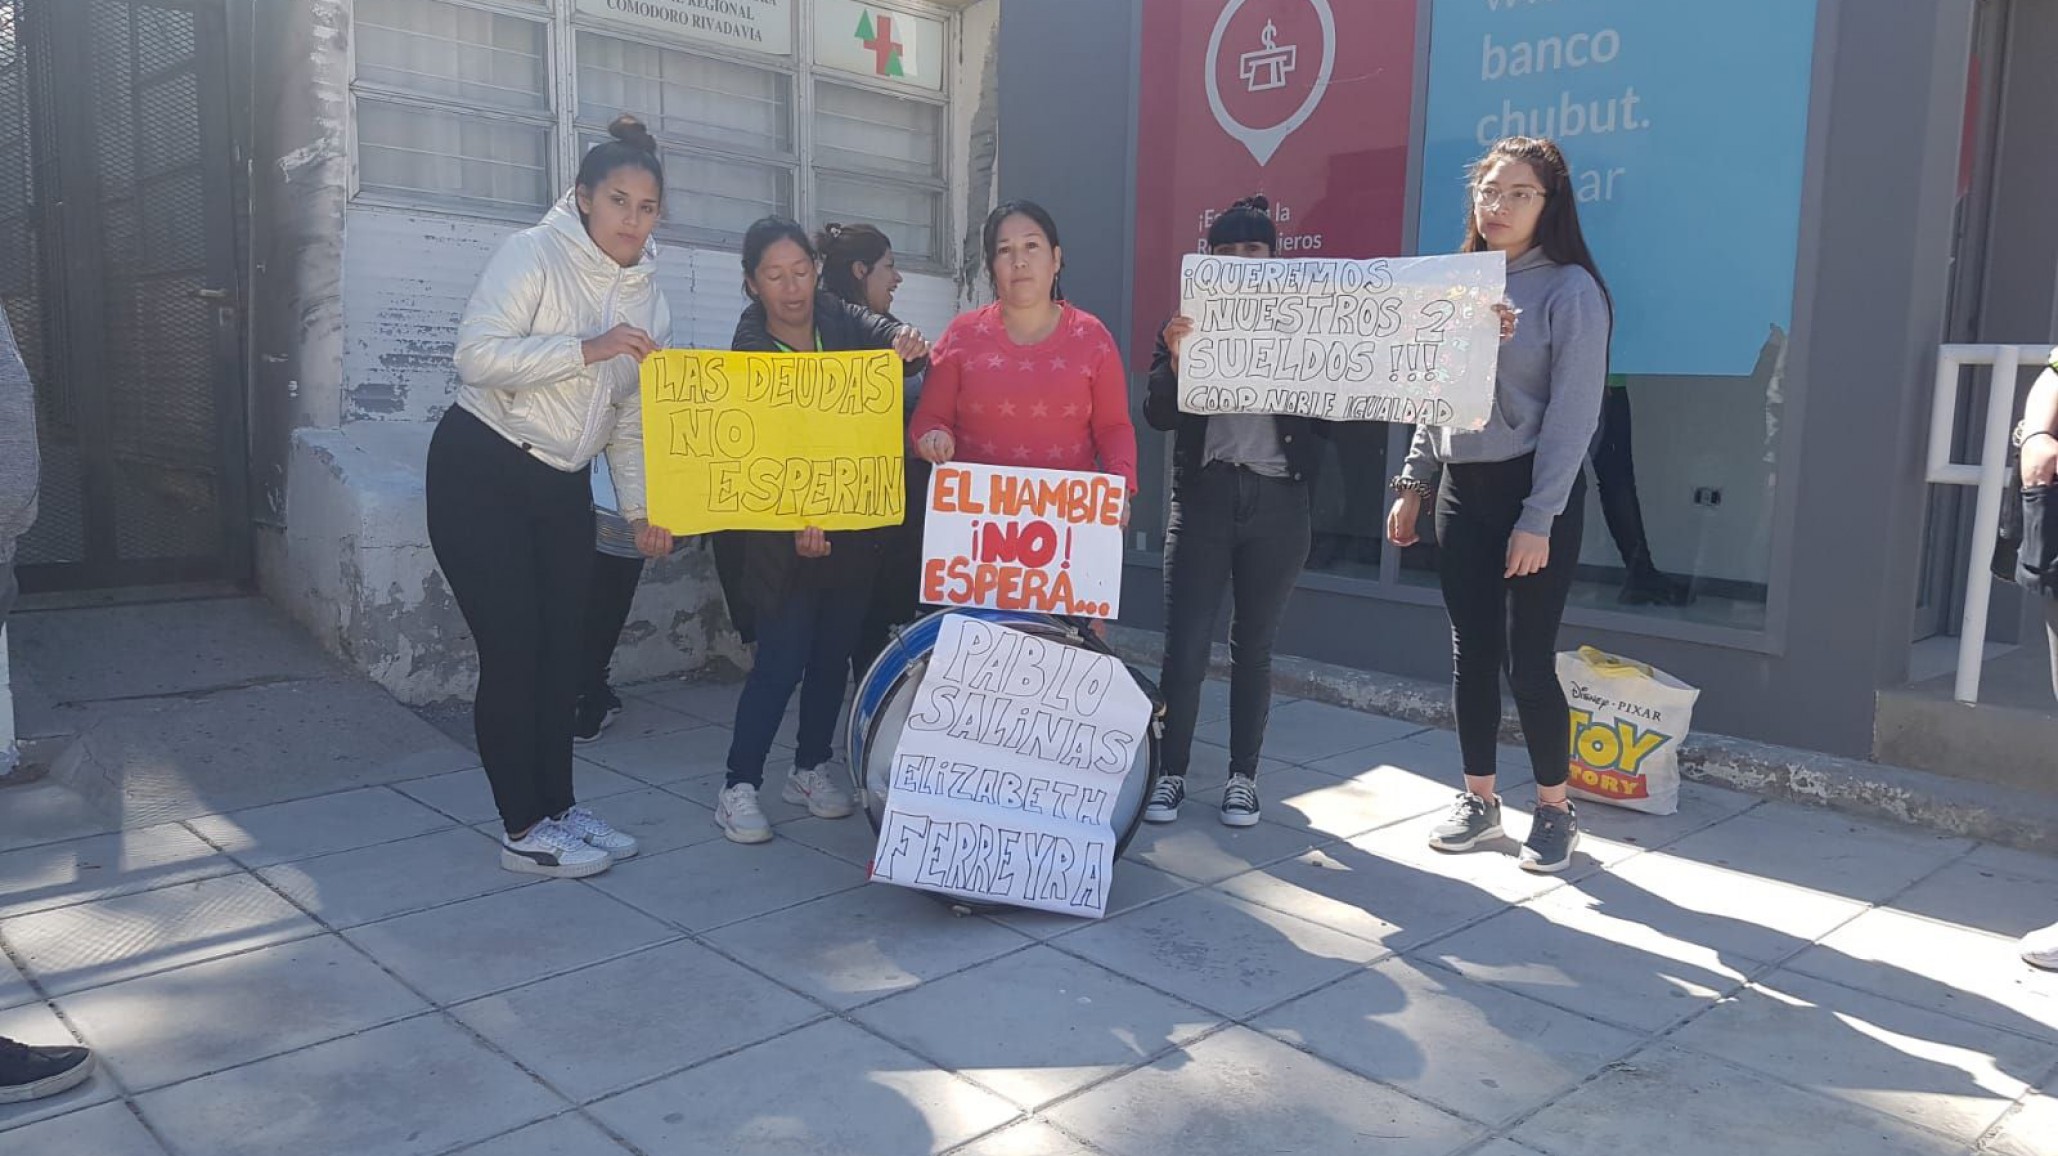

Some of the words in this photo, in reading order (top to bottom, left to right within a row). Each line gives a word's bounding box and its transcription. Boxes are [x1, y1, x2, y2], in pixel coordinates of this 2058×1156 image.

[606, 0, 689, 26] COMODORO
[692, 14, 763, 43] RIVADAVIA
[692, 0, 755, 21] REGIONAL
[1481, 27, 1621, 81] banco
[1475, 85, 1651, 147] chubut.
[1275, 201, 1290, 222] la
[1183, 258, 1394, 299] ¡QUEREMOS
[1200, 294, 1402, 337] NUESTROS
[1414, 299, 1456, 343] 2
[654, 356, 730, 404] LAS
[745, 353, 895, 414] DEUDAS
[1187, 337, 1376, 382] SUELDOS
[1184, 385, 1259, 413] COOP
[1343, 394, 1454, 424] IGUALDAD
[669, 408, 756, 459] NO
[707, 456, 902, 517] ESPERAN
[932, 468, 984, 515] EL
[988, 474, 1123, 526] HAMBRE
[943, 619, 1114, 718] PABLO
[1617, 701, 1662, 722] PIXAR
[1569, 707, 1673, 777] TOY
[1569, 763, 1638, 795] TORY
[874, 810, 1105, 910] FERREYRA
